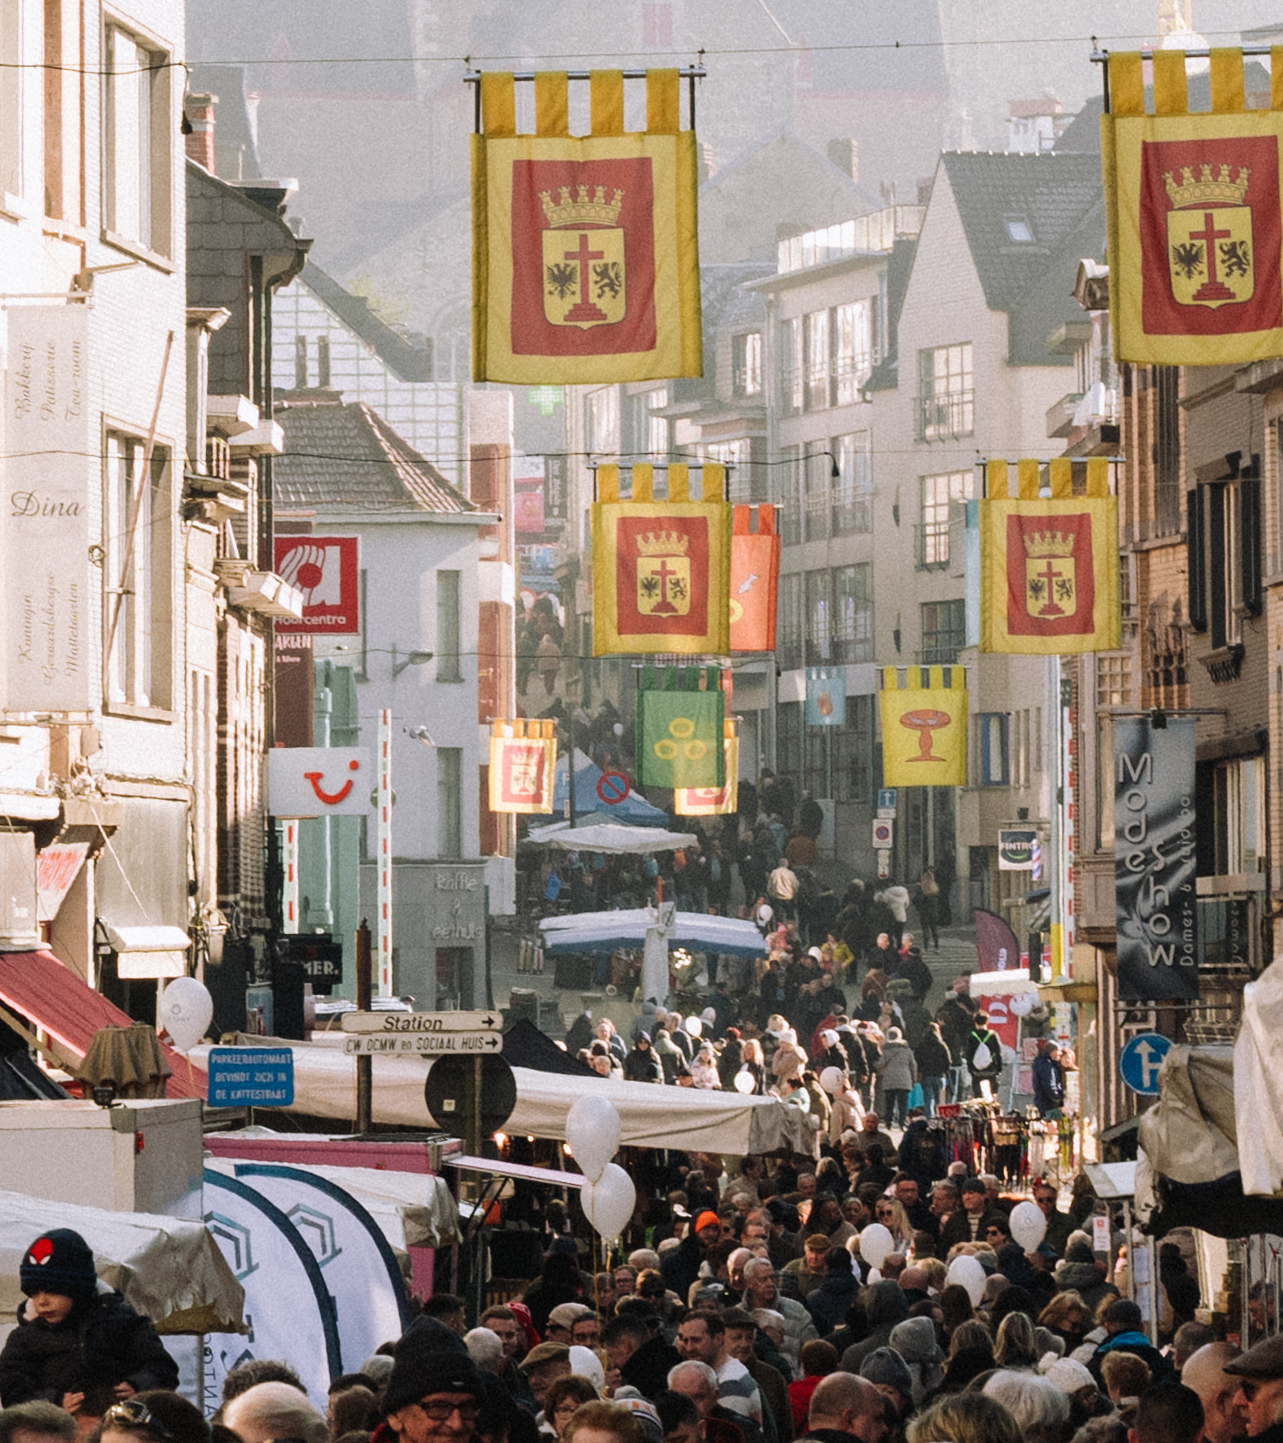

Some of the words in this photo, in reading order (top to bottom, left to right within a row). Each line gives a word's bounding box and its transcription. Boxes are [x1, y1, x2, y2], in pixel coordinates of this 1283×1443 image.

[40, 340, 59, 421] Patisserie
[11, 490, 86, 518] Dina
[1179, 902, 1194, 967] Dames-
[382, 1016, 443, 1031] Station
[346, 1039, 362, 1053] CW
[366, 1038, 397, 1052] OCMW
[401, 1040, 412, 1051] en
[416, 1037, 457, 1051] SOCIAAL
[461, 1037, 485, 1050] HUIS
[211, 1053, 292, 1065] PARKEERAUTOMAAT
[215, 1072, 250, 1083] BEVINDT
[254, 1072, 274, 1083] ZICH
[277, 1072, 287, 1082] IN
[215, 1089, 227, 1100] DE
[230, 1089, 287, 1100] KATTESTRAAT
